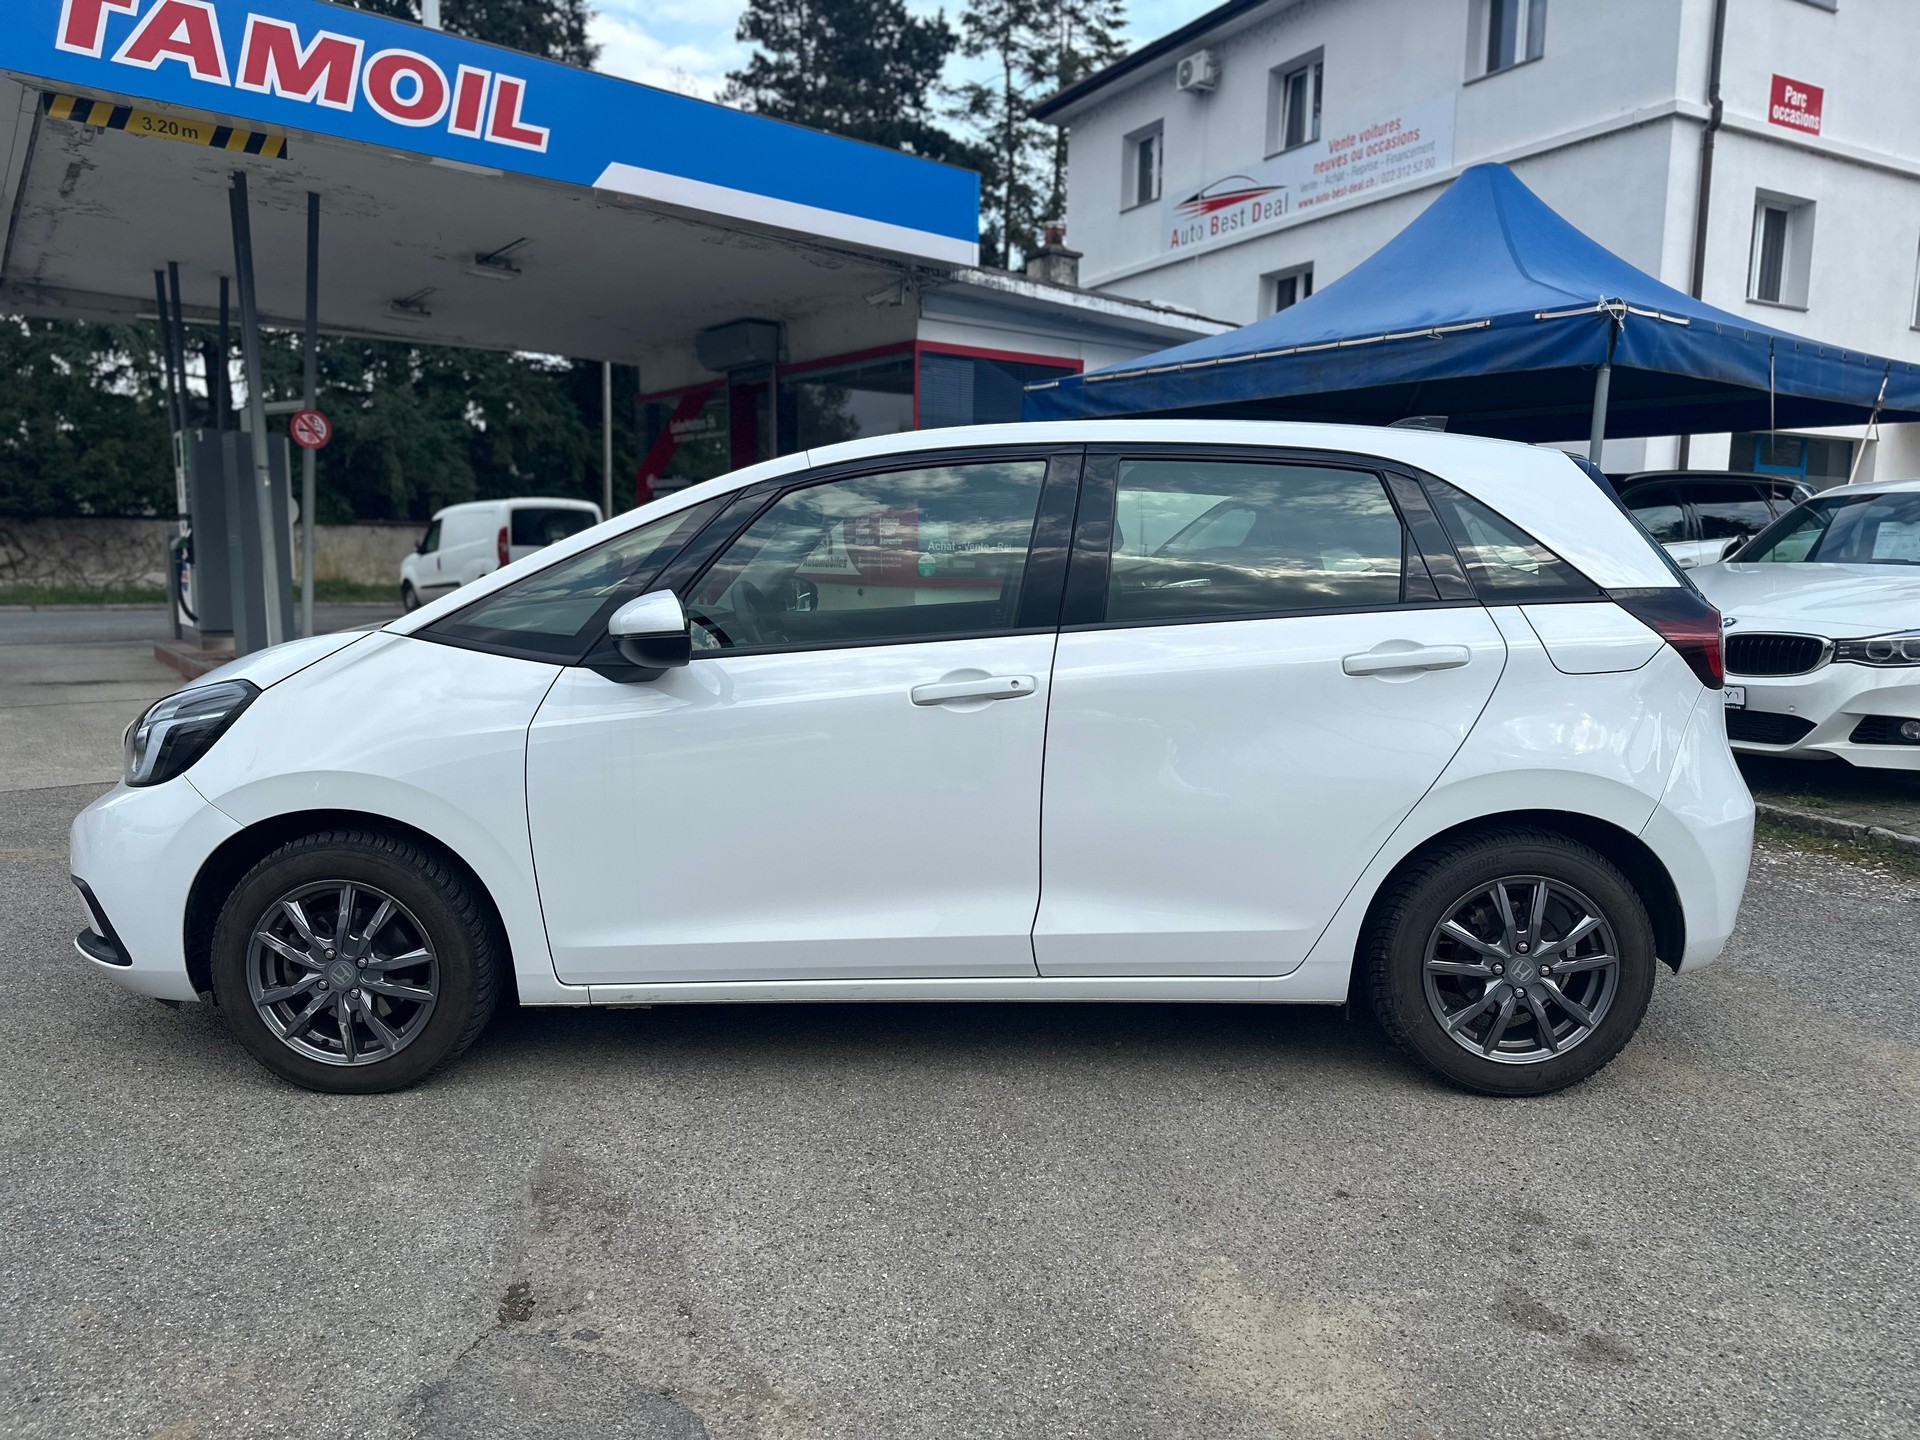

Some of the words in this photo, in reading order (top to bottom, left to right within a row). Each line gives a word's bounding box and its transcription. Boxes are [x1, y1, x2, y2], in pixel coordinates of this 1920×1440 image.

[54, 0, 551, 154] TAMOIL
[1784, 85, 1807, 108] Parc
[142, 116, 179, 136] 3.20
[182, 126, 199, 140] m
[1772, 104, 1820, 130] occasions
[1328, 134, 1356, 154] Vente
[1359, 118, 1402, 143] voitures
[1313, 153, 1348, 175] neuves
[1350, 148, 1363, 162] ou
[1366, 128, 1420, 157] occasions
[1385, 140, 1436, 166] Financement
[1170, 224, 1204, 249] Auto
[1210, 207, 1245, 236] Best
[1252, 192, 1289, 223] Deal
[927, 541, 955, 551] Achat
[964, 541, 989, 552] Vente
[801, 556, 848, 569] Automobiles
